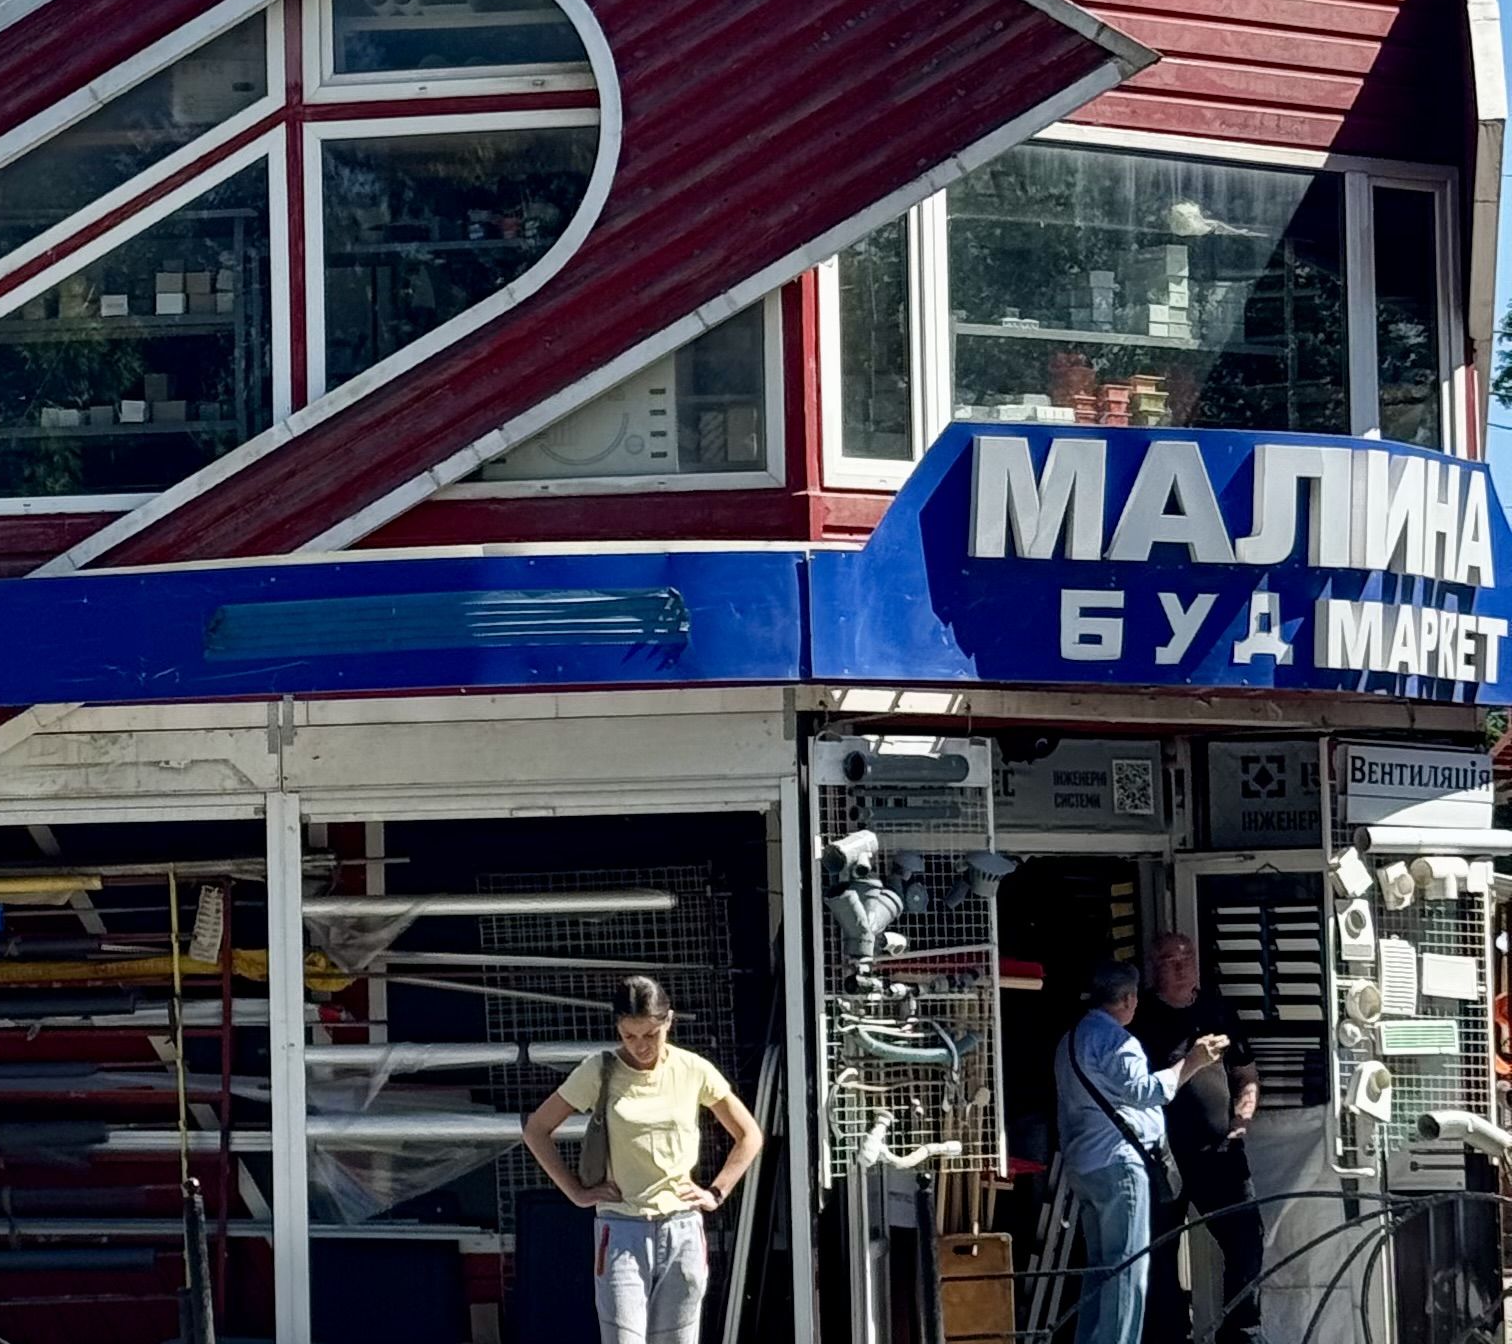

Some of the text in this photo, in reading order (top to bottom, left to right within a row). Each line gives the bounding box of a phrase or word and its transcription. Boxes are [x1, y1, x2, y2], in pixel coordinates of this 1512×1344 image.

[969, 435, 1496, 588] МАЛИНА
[1059, 588, 1509, 684] БУД МАРКЕТ
